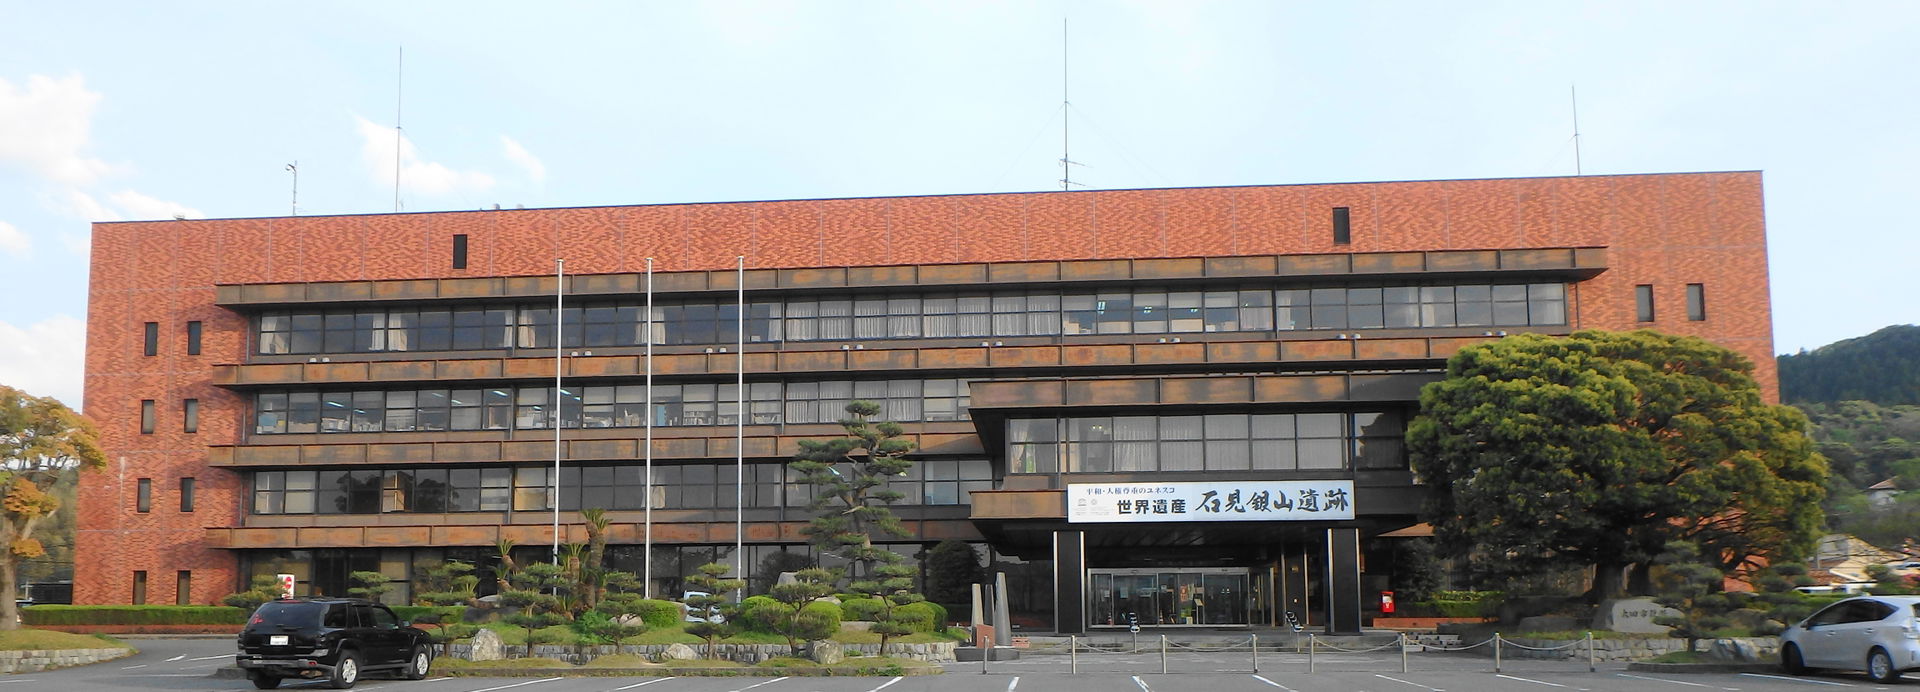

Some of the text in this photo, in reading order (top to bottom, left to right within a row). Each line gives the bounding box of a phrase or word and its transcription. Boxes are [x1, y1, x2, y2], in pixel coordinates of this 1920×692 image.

[1116, 498, 1187, 515] 世界遺産
[1195, 488, 1349, 513] 石見銀山遺跡
